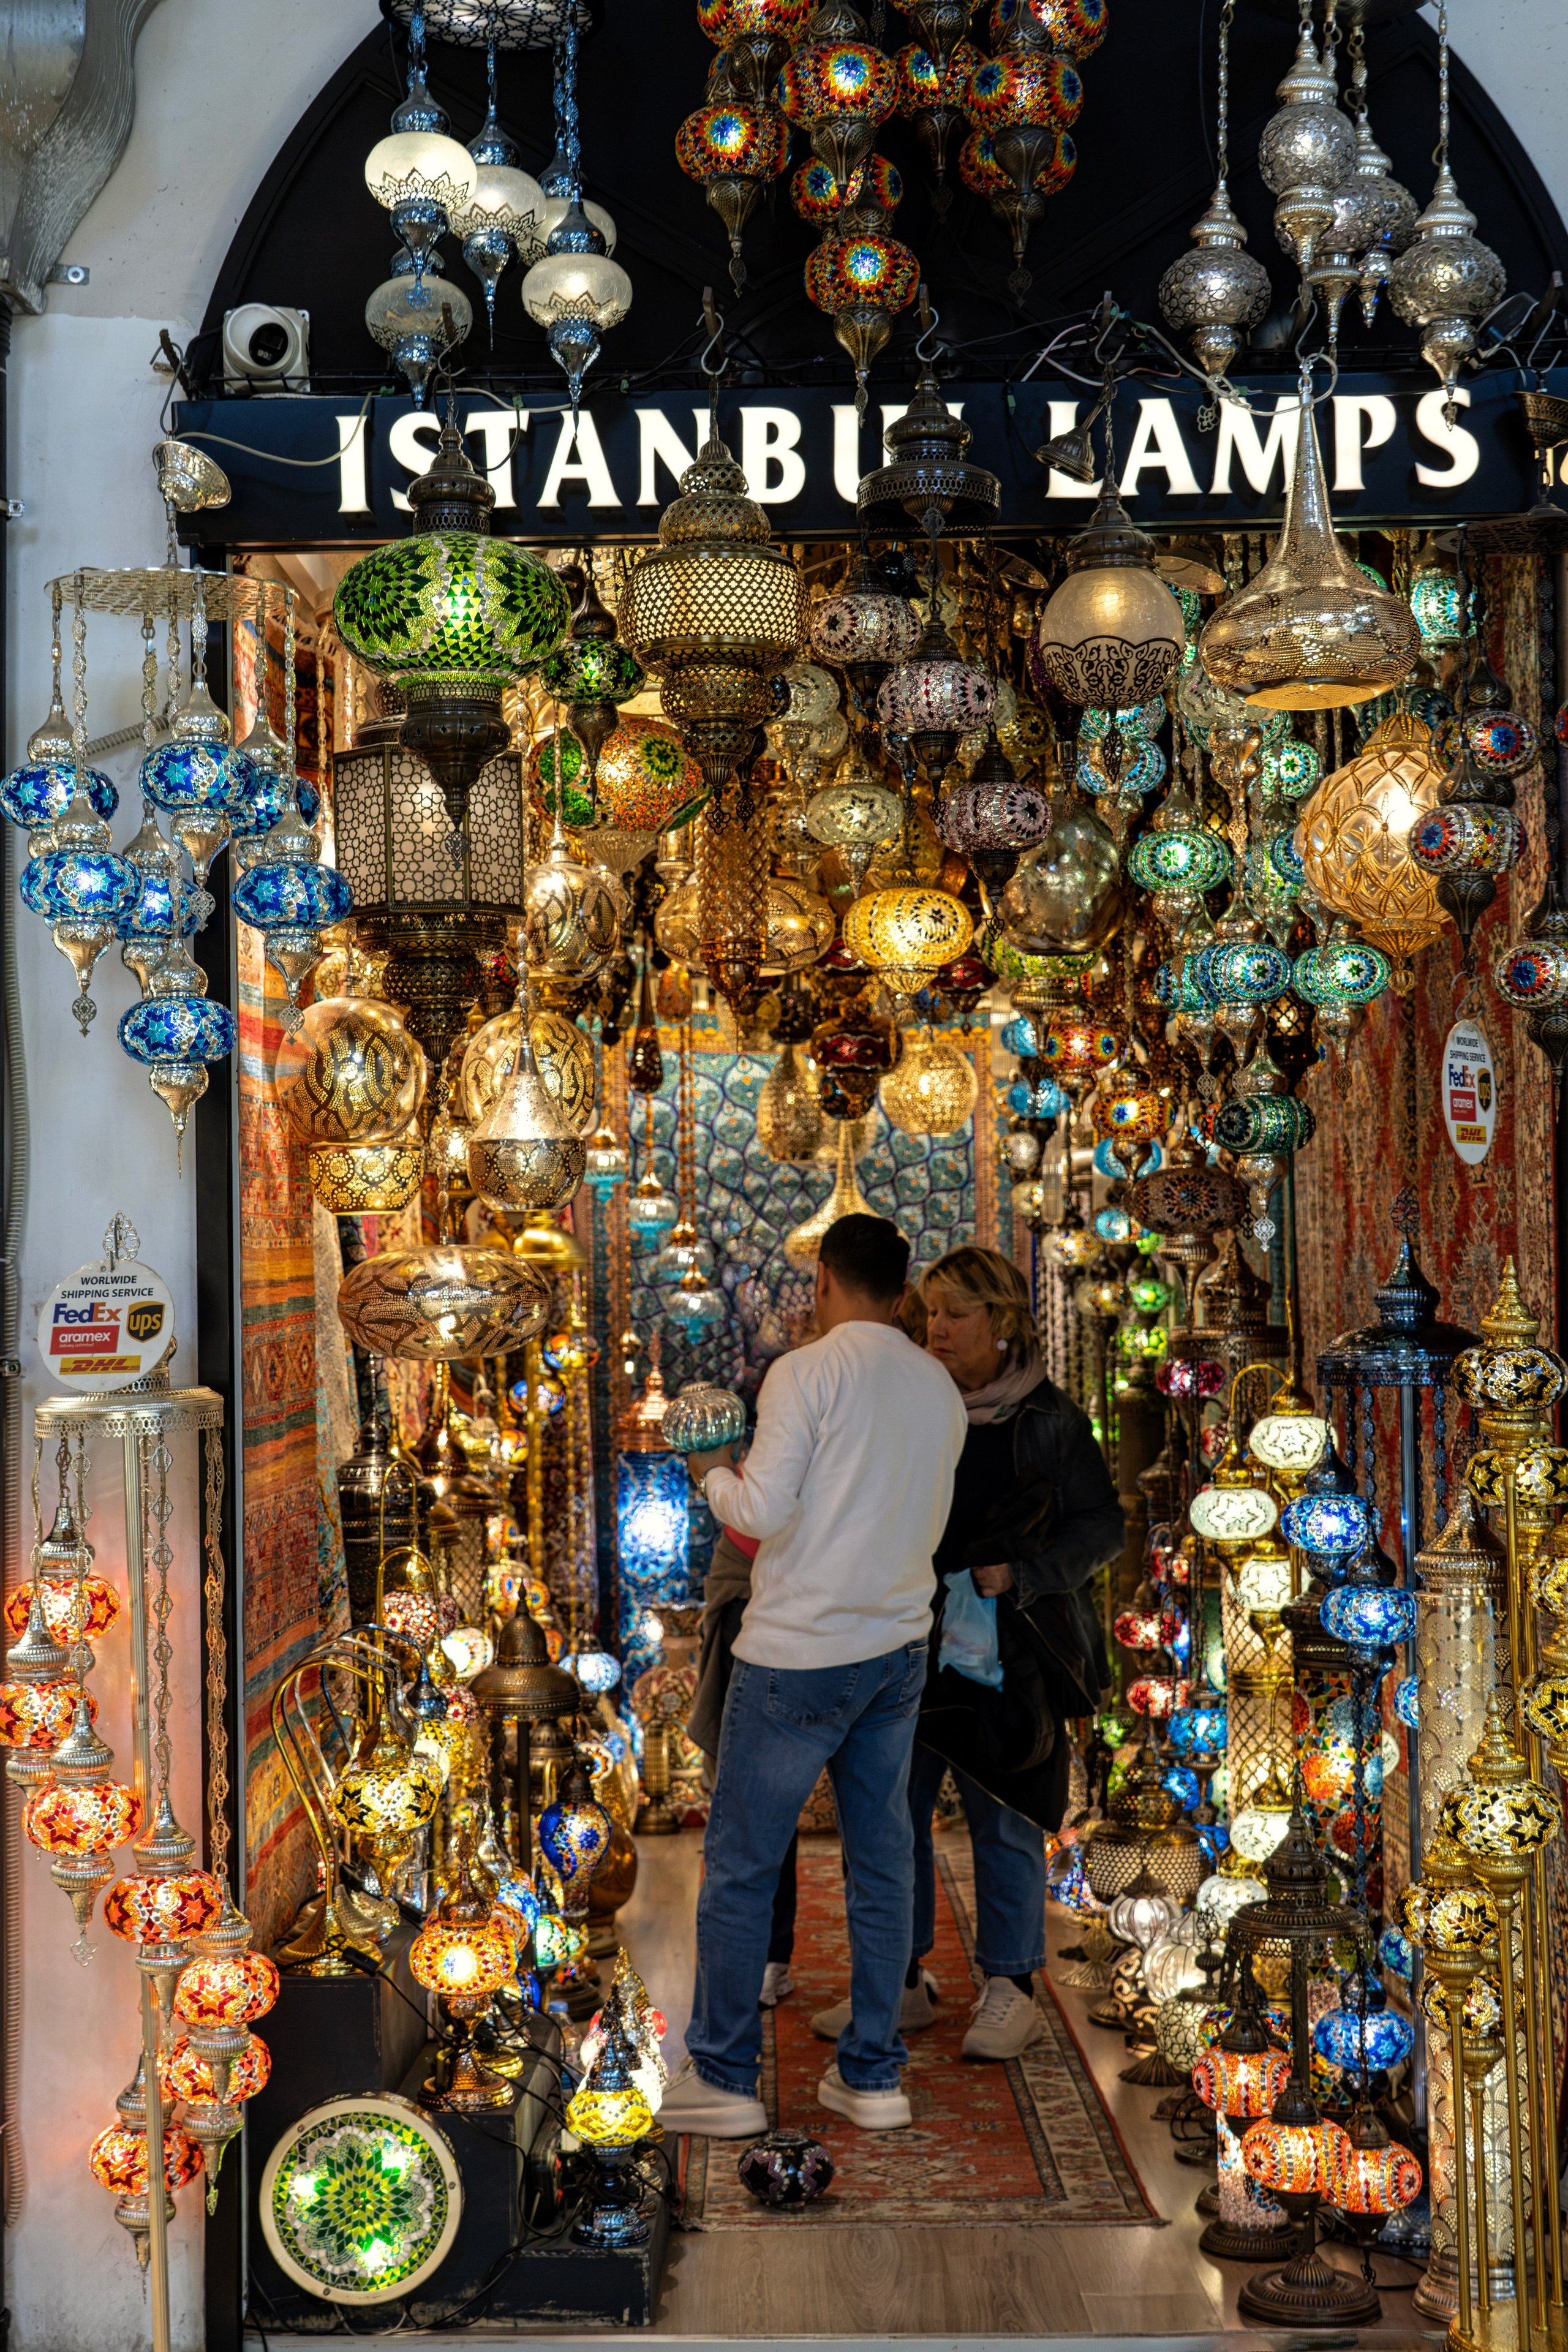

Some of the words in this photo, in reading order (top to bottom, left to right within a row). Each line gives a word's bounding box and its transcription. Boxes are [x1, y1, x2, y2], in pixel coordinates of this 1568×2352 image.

[335, 402, 965, 513] ISTANBU
[1045, 387, 1480, 498] LAMPS
[1450, 1050, 1469, 1061] SHIPPING
[1469, 1052, 1487, 1063] SERVICE
[1449, 1063, 1476, 1088] FedEx
[1479, 1082, 1491, 1107] ups
[1452, 1098, 1474, 1109] aramex
[1460, 1128, 1483, 1142] DHL
[81, 1275, 138, 1286] WORLWIDE
[61, 1289, 110, 1299] SHIPPING
[111, 1287, 154, 1298] SERVICE
[53, 1302, 123, 1324] FedEx
[129, 1313, 161, 1337] ups
[58, 1331, 111, 1343] aramex
[70, 1359, 130, 1372] DHL
